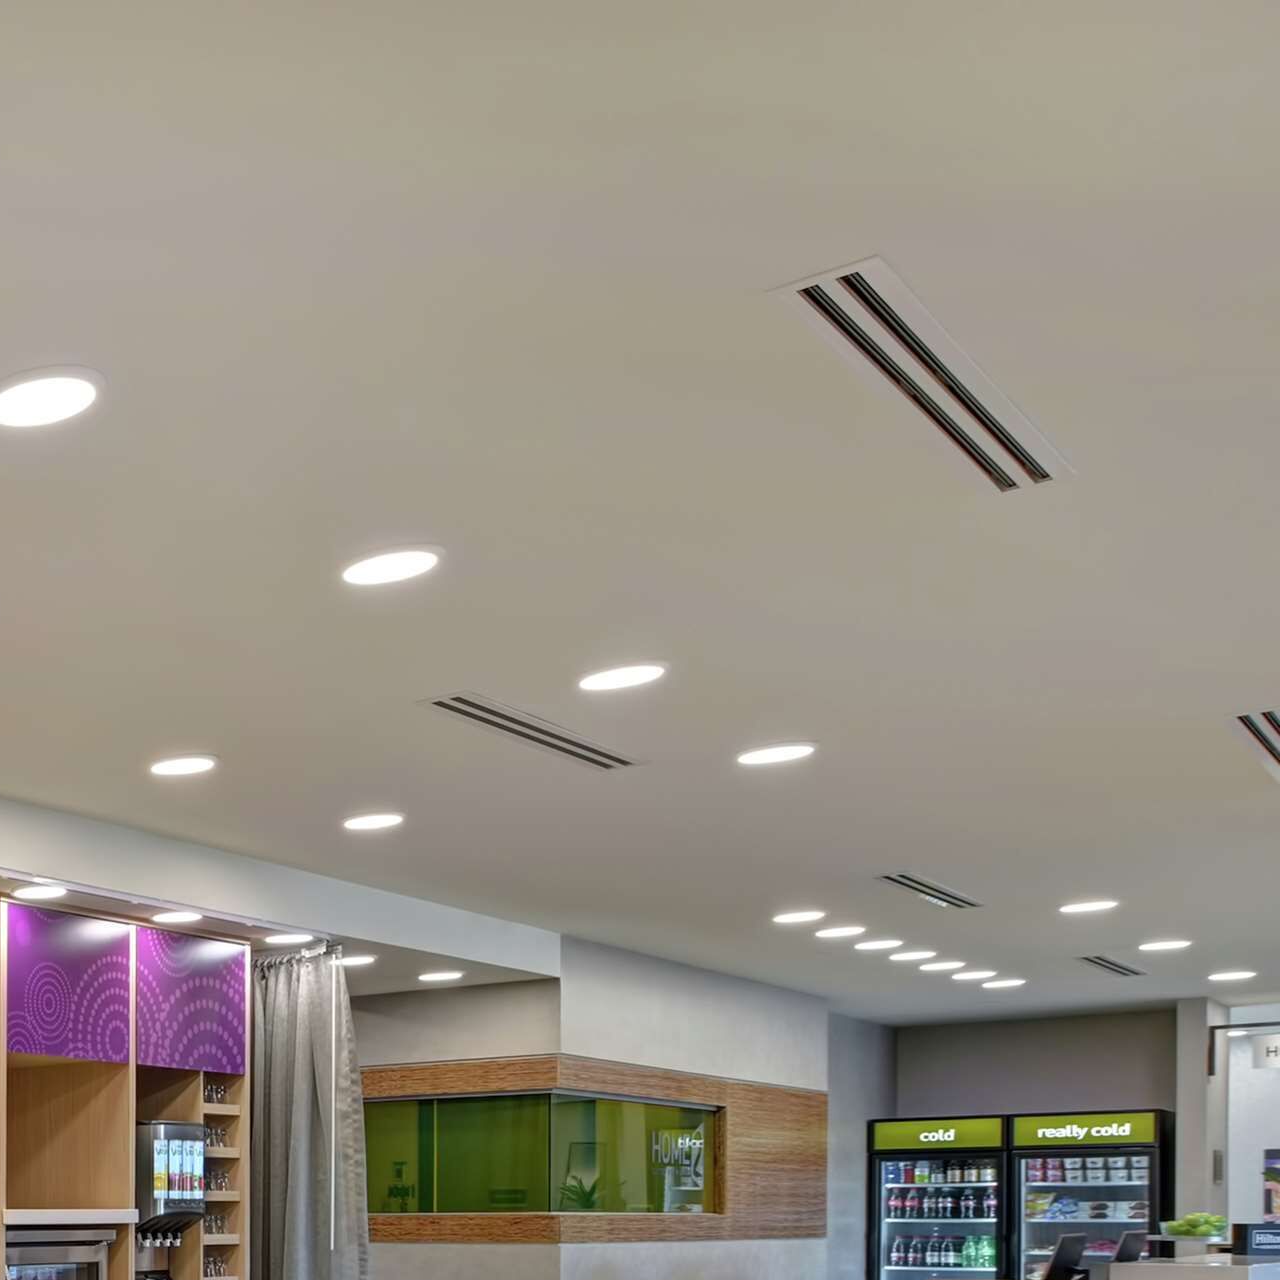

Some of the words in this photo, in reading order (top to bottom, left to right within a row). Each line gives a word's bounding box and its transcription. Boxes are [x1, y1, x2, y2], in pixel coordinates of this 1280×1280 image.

[919, 1129, 956, 1142] cold
[1037, 1123, 1088, 1140] really
[1091, 1123, 1132, 1137] cold
